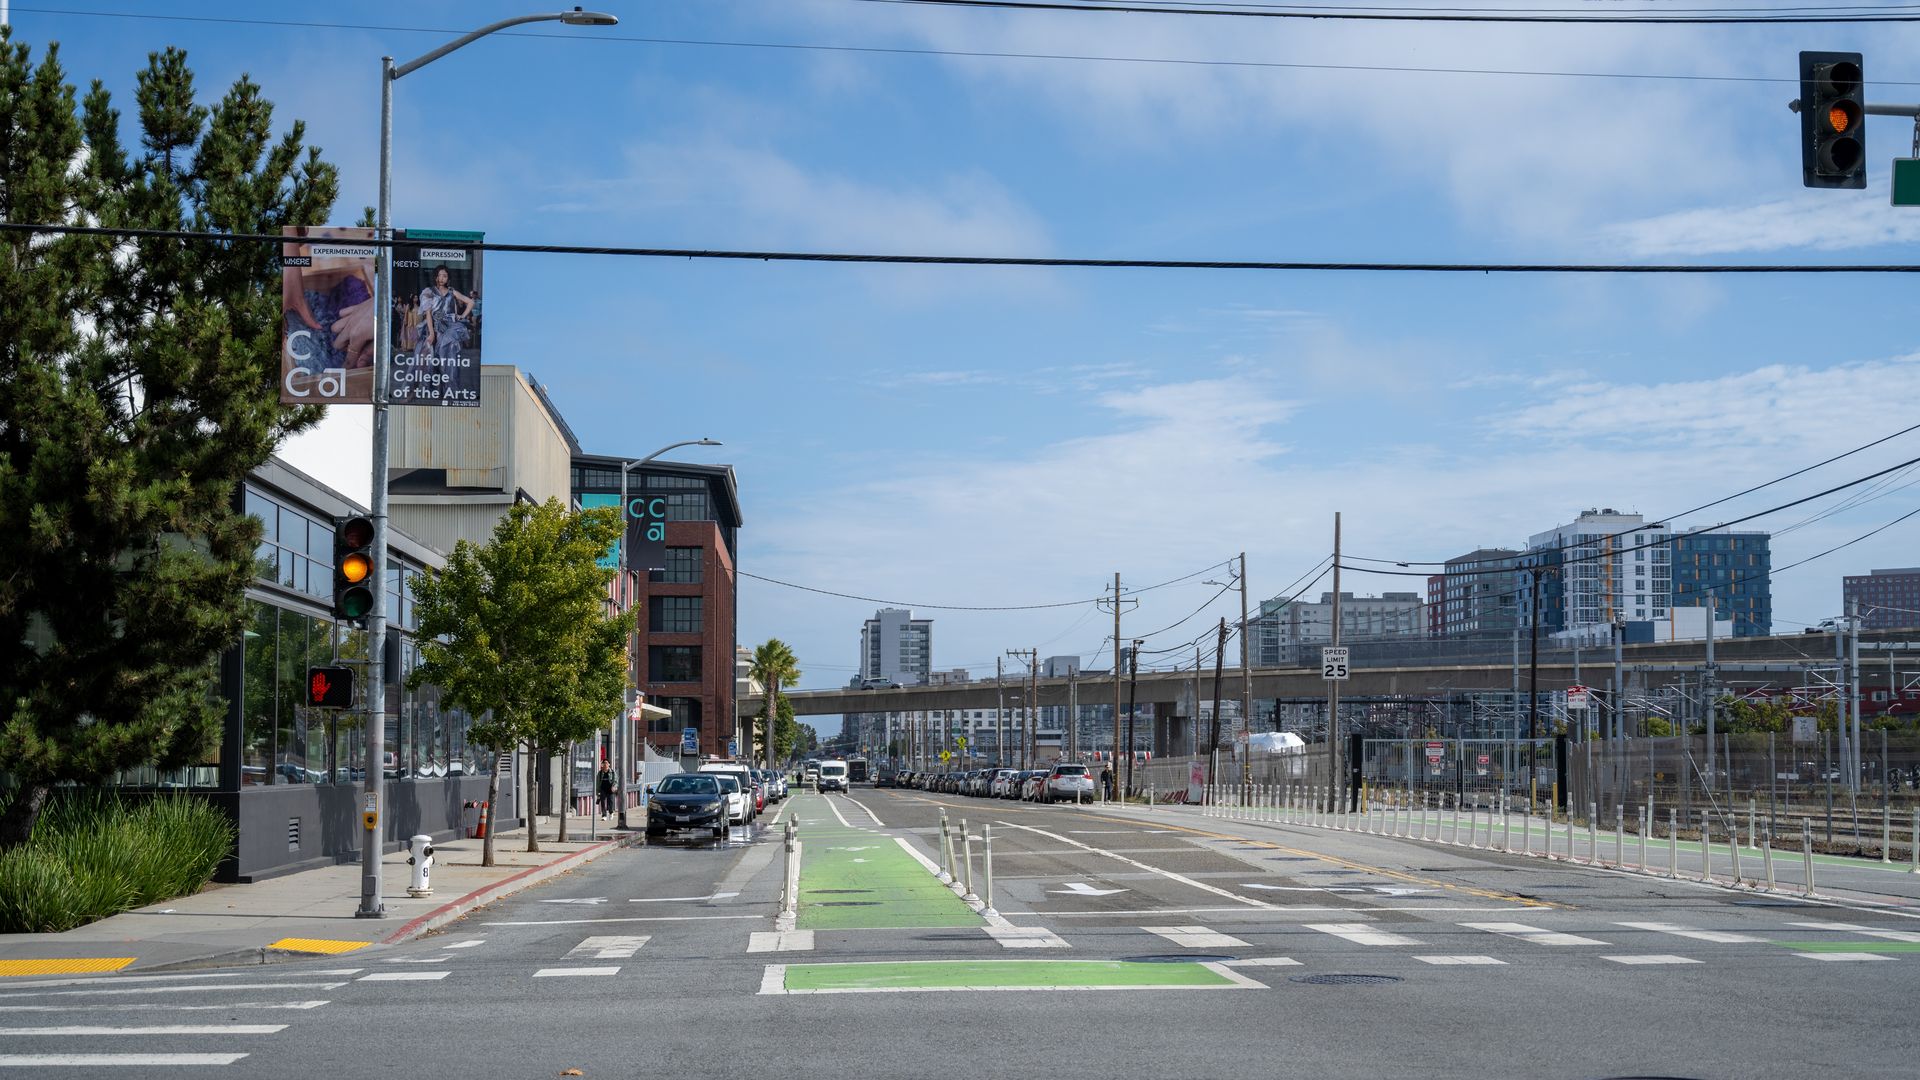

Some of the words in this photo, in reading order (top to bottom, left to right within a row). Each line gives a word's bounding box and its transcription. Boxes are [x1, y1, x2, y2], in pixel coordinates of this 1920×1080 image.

[313, 248, 374, 256] EXPERIMENTATION
[422, 250, 464, 258] EXPRESSION
[284, 258, 310, 266] WHERE
[394, 354, 470, 368] California
[394, 370, 449, 385] College
[393, 387, 408, 399] of
[414, 387, 440, 399] the
[443, 388, 476, 400] Arts
[1324, 665, 1347, 677] 25
[422, 867, 428, 877] 8
